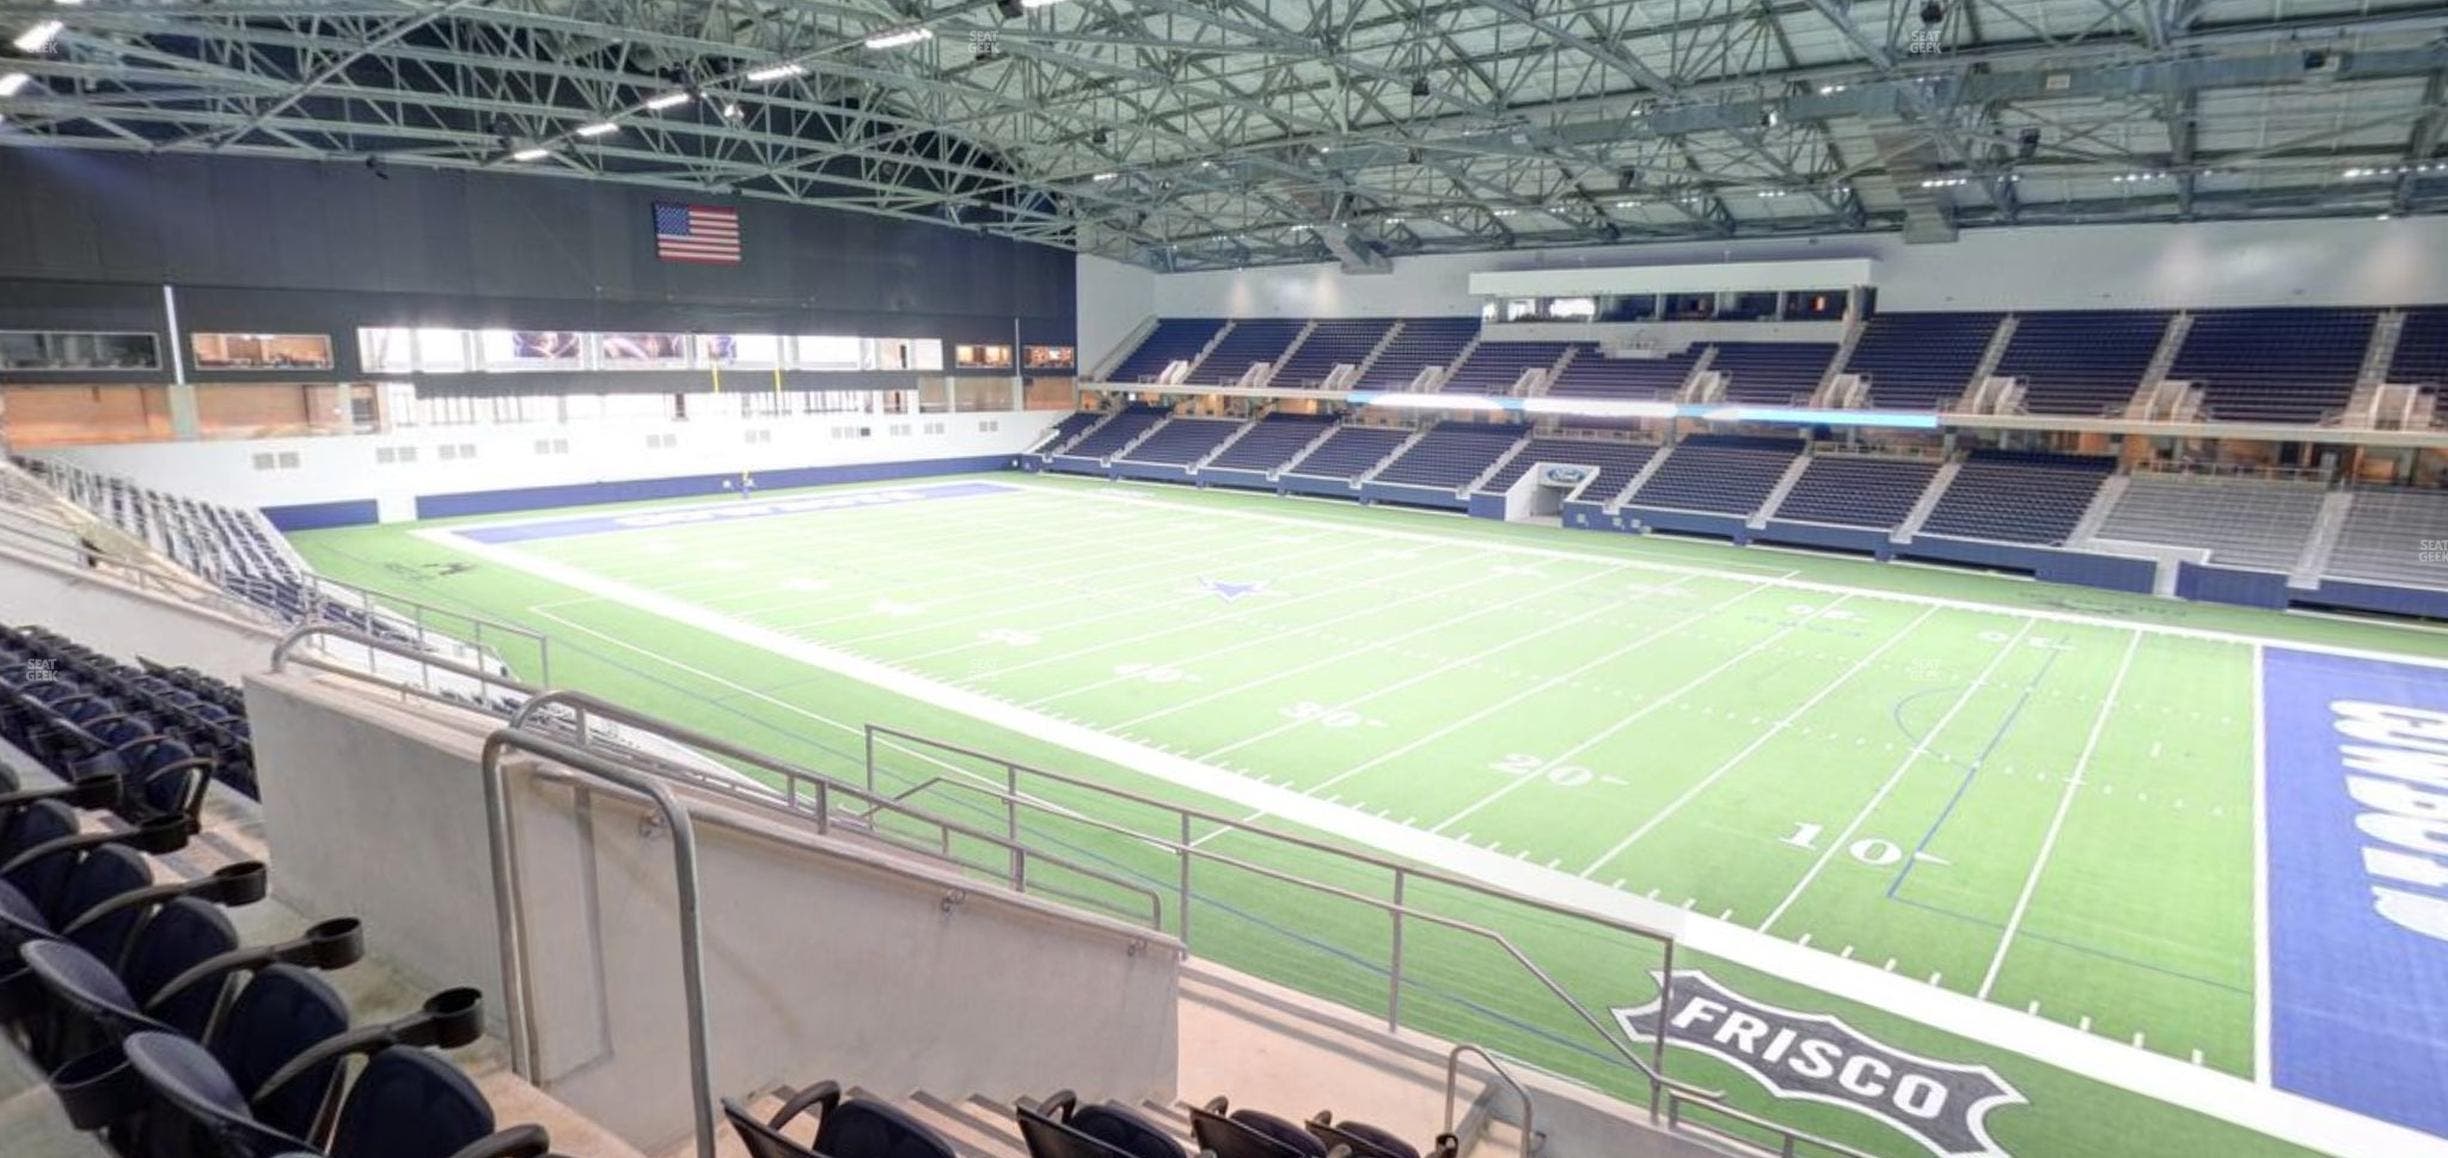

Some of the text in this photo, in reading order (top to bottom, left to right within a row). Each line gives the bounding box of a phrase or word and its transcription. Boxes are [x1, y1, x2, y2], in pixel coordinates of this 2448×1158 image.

[1488, 753, 1593, 786] 20
[1778, 822, 1903, 866] 10
[1671, 996, 1949, 1119] FRISCO
